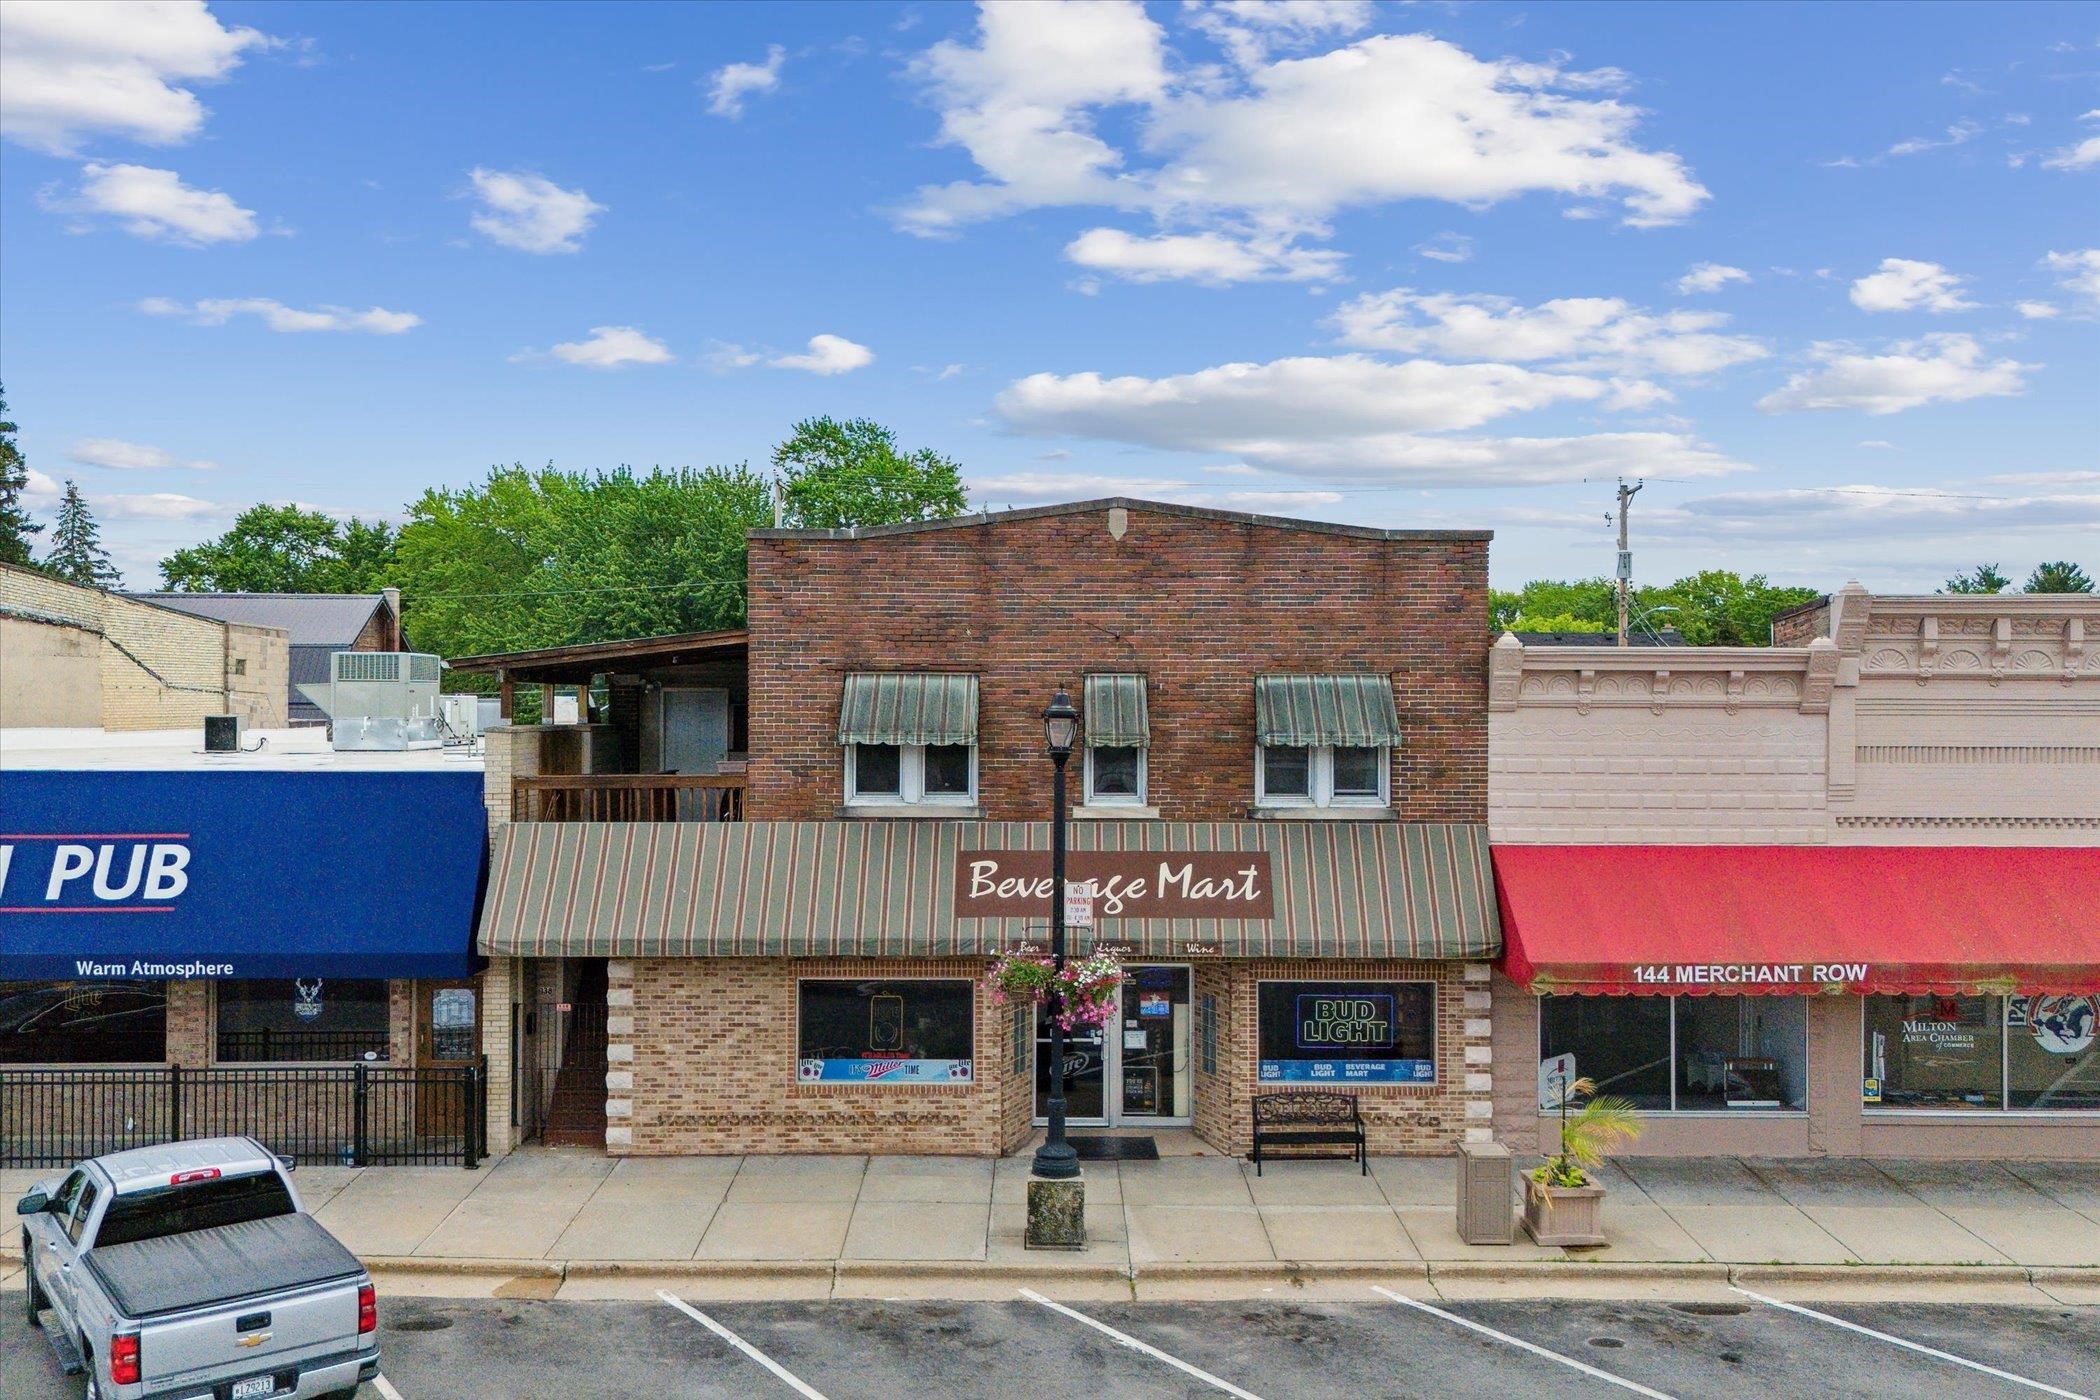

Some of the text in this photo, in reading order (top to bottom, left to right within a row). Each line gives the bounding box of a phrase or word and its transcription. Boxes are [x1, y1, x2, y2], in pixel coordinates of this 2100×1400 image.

[45, 844, 191, 900] PUB
[969, 860, 1261, 914] Beveage Mart
[1073, 886, 1084, 895] NO
[1066, 897, 1091, 905] PARKING
[1020, 941, 1214, 954] Beer Liquor Wine
[76, 960, 234, 979] Warm Atmosphere
[1633, 964, 1867, 983] 144 MERCHANT ROW
[1315, 1001, 1376, 1021] BUD
[1304, 1021, 1388, 1042] LIGHT
[1936, 1041, 1943, 1050] of
[801, 1059, 813, 1067] Lite
[866, 1060, 904, 1077] Miller
[904, 1065, 920, 1075] TIME
[958, 1059, 971, 1067] Lite
[1413, 1070, 1433, 1078] LIGHT
